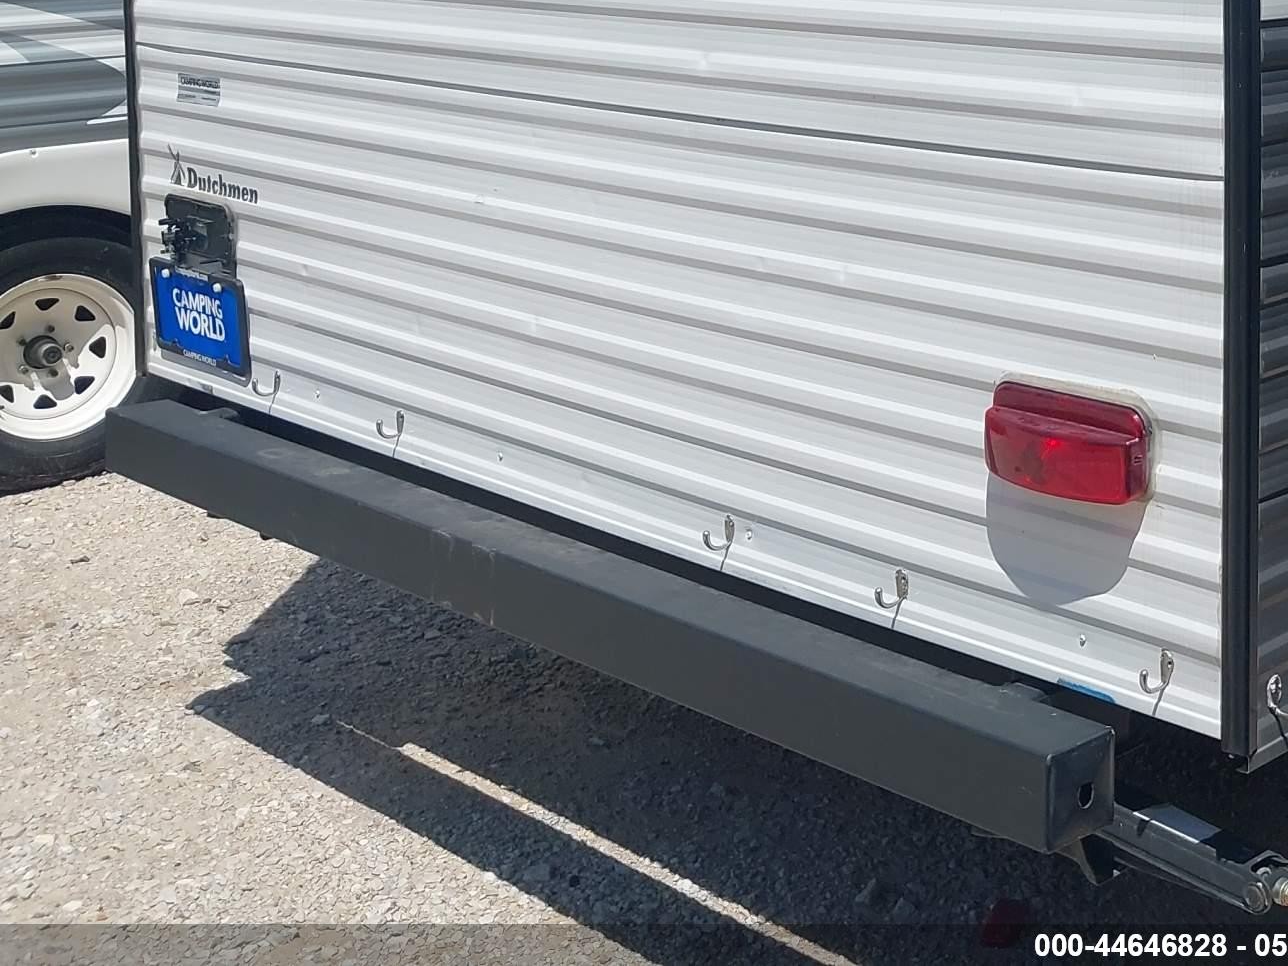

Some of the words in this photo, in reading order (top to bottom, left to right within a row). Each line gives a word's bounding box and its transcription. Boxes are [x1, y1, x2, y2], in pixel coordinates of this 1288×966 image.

[186, 167, 258, 204] Dutchmen
[172, 288, 223, 320] CAMPING
[175, 306, 225, 341] WORLD
